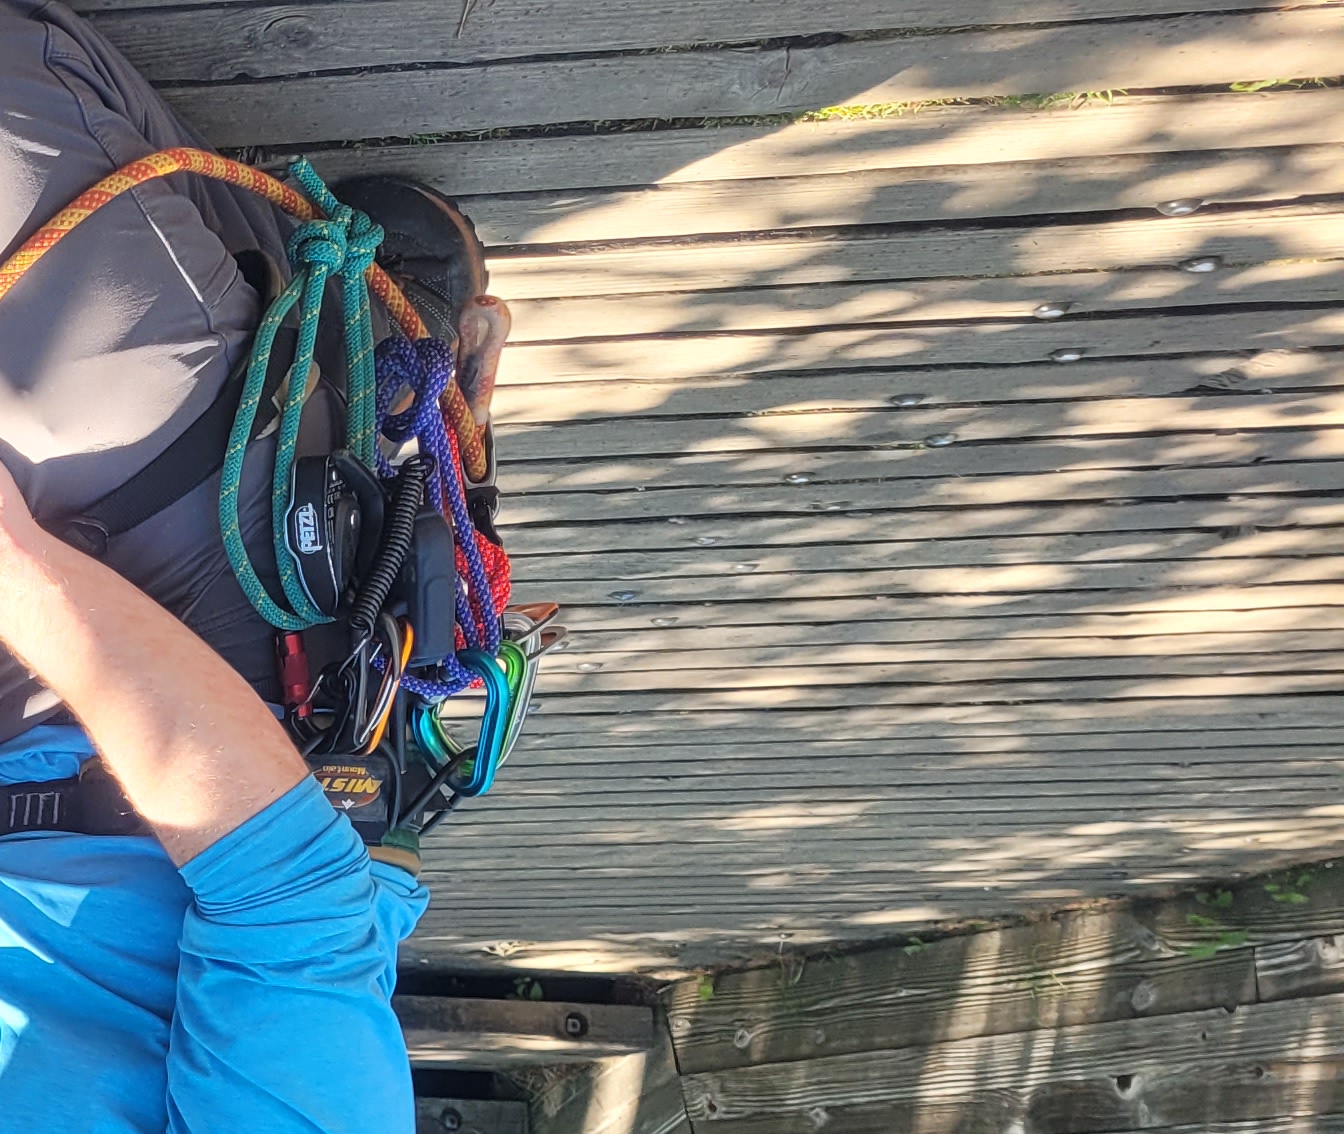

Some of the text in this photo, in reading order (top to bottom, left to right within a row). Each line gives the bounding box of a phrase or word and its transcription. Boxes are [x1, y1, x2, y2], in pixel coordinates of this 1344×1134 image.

[298, 502, 323, 552] PETZL
[322, 765, 366, 776] Mountain
[321, 777, 383, 794] MIST
